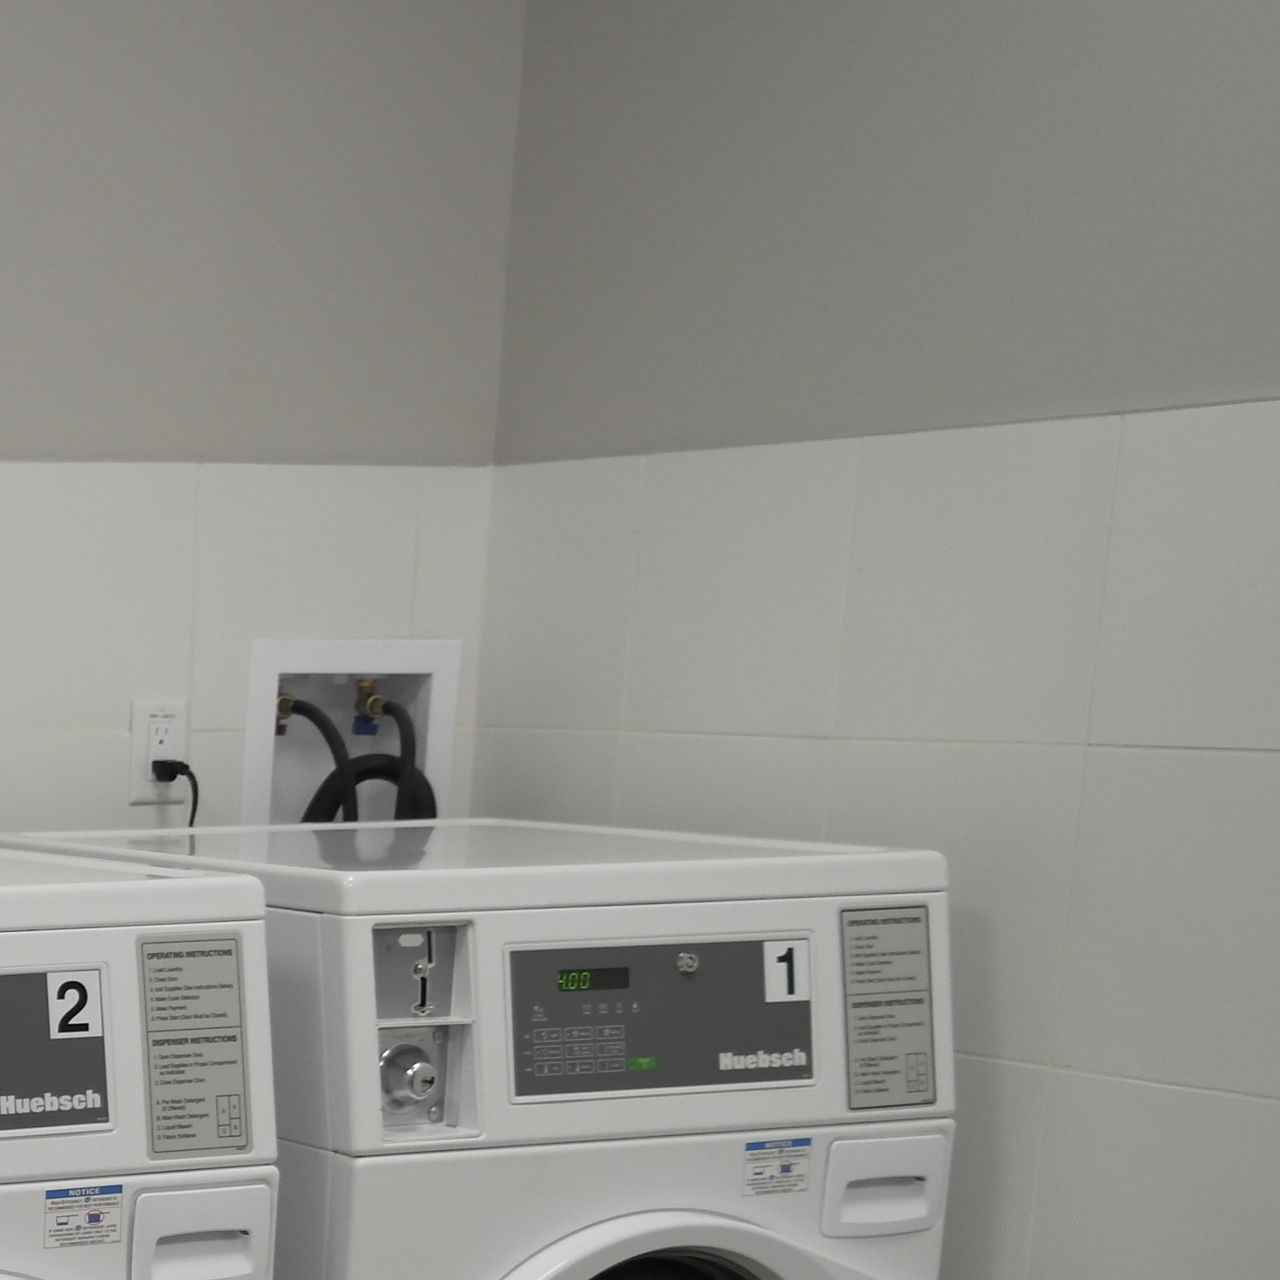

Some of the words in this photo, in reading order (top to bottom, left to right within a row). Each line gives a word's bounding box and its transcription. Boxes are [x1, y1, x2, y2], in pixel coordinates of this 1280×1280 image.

[776, 947, 795, 995] 1
[56, 980, 89, 1033] 2
[719, 1048, 807, 1070] Huebsch
[0, 1089, 101, 1115] Huebsch
[68, 1187, 100, 1196] NOTICE
